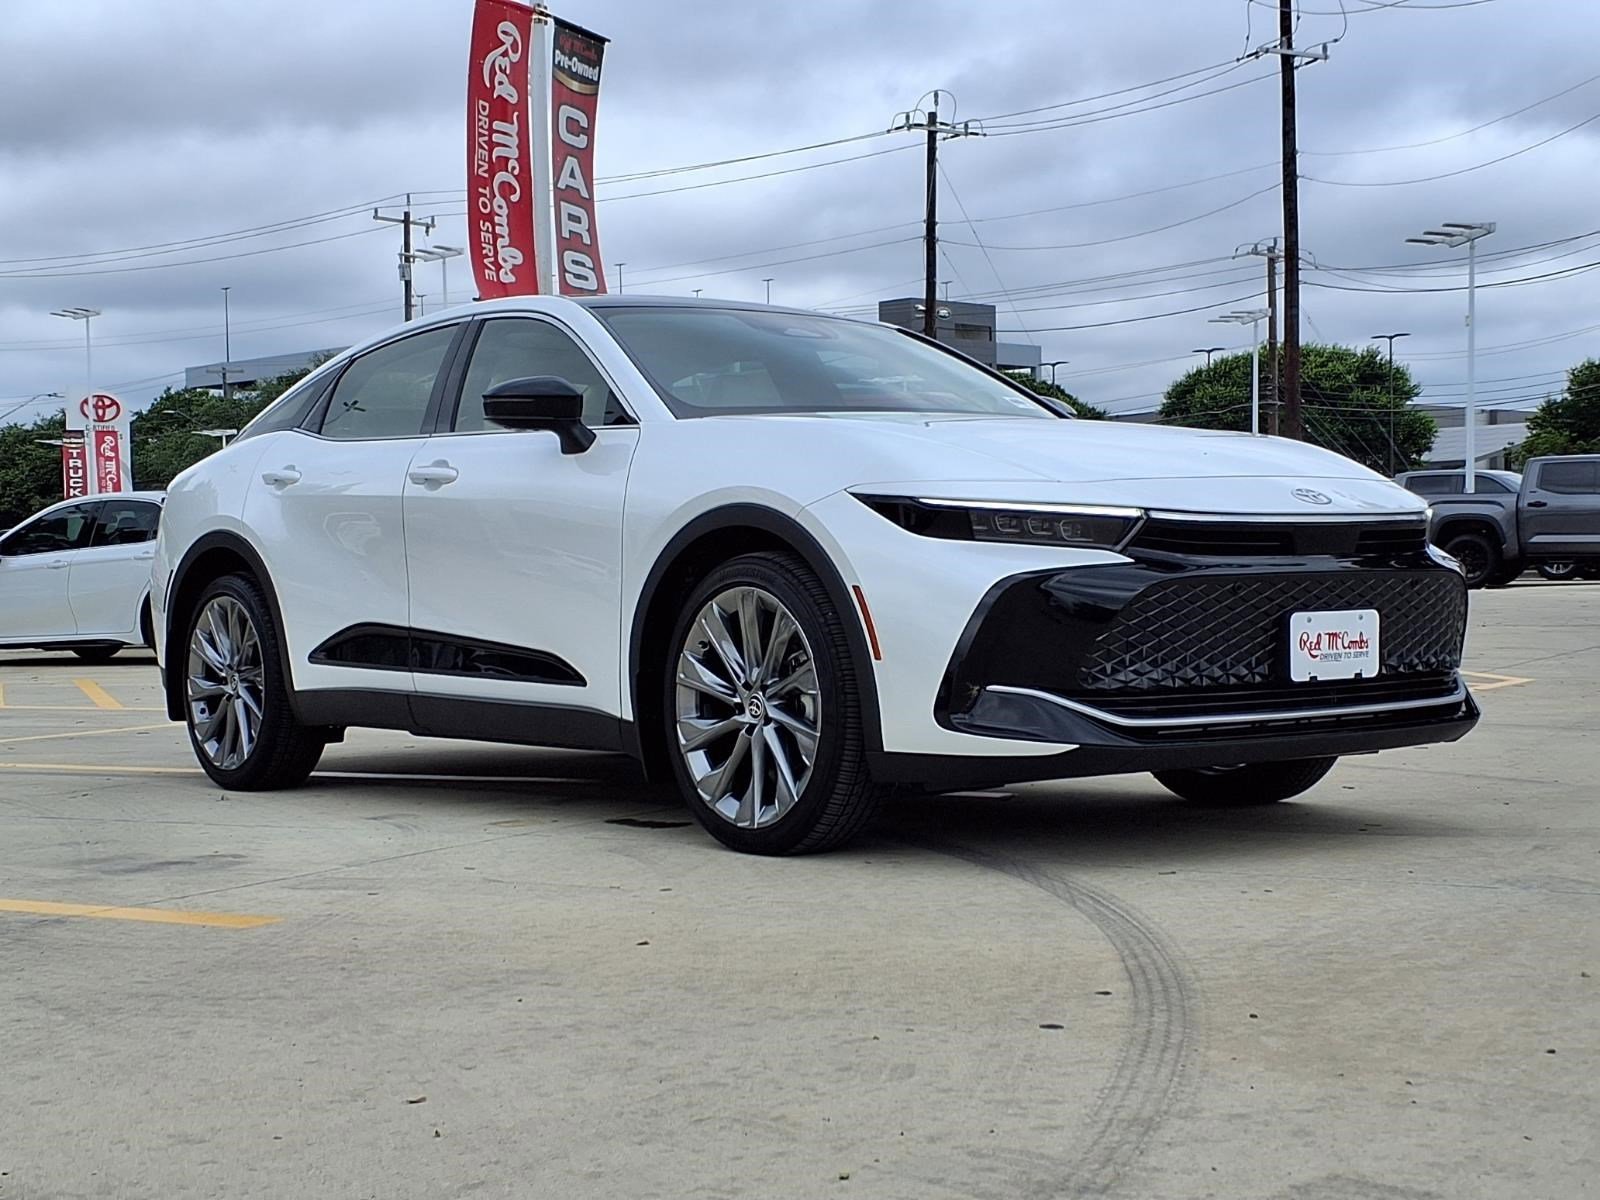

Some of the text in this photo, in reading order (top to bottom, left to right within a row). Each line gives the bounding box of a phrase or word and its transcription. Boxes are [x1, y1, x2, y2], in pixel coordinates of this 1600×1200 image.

[555, 49, 599, 81] Pre-Owned
[483, 21, 524, 284] Red McCombs
[477, 99, 497, 282] DRIVEN TO SERVE
[557, 104, 599, 291] CARS
[101, 435, 116, 457] Red
[1299, 631, 1369, 659] Red McCombs
[1320, 652, 1342, 660] DRIVEN
[1353, 651, 1369, 659] SERVE
